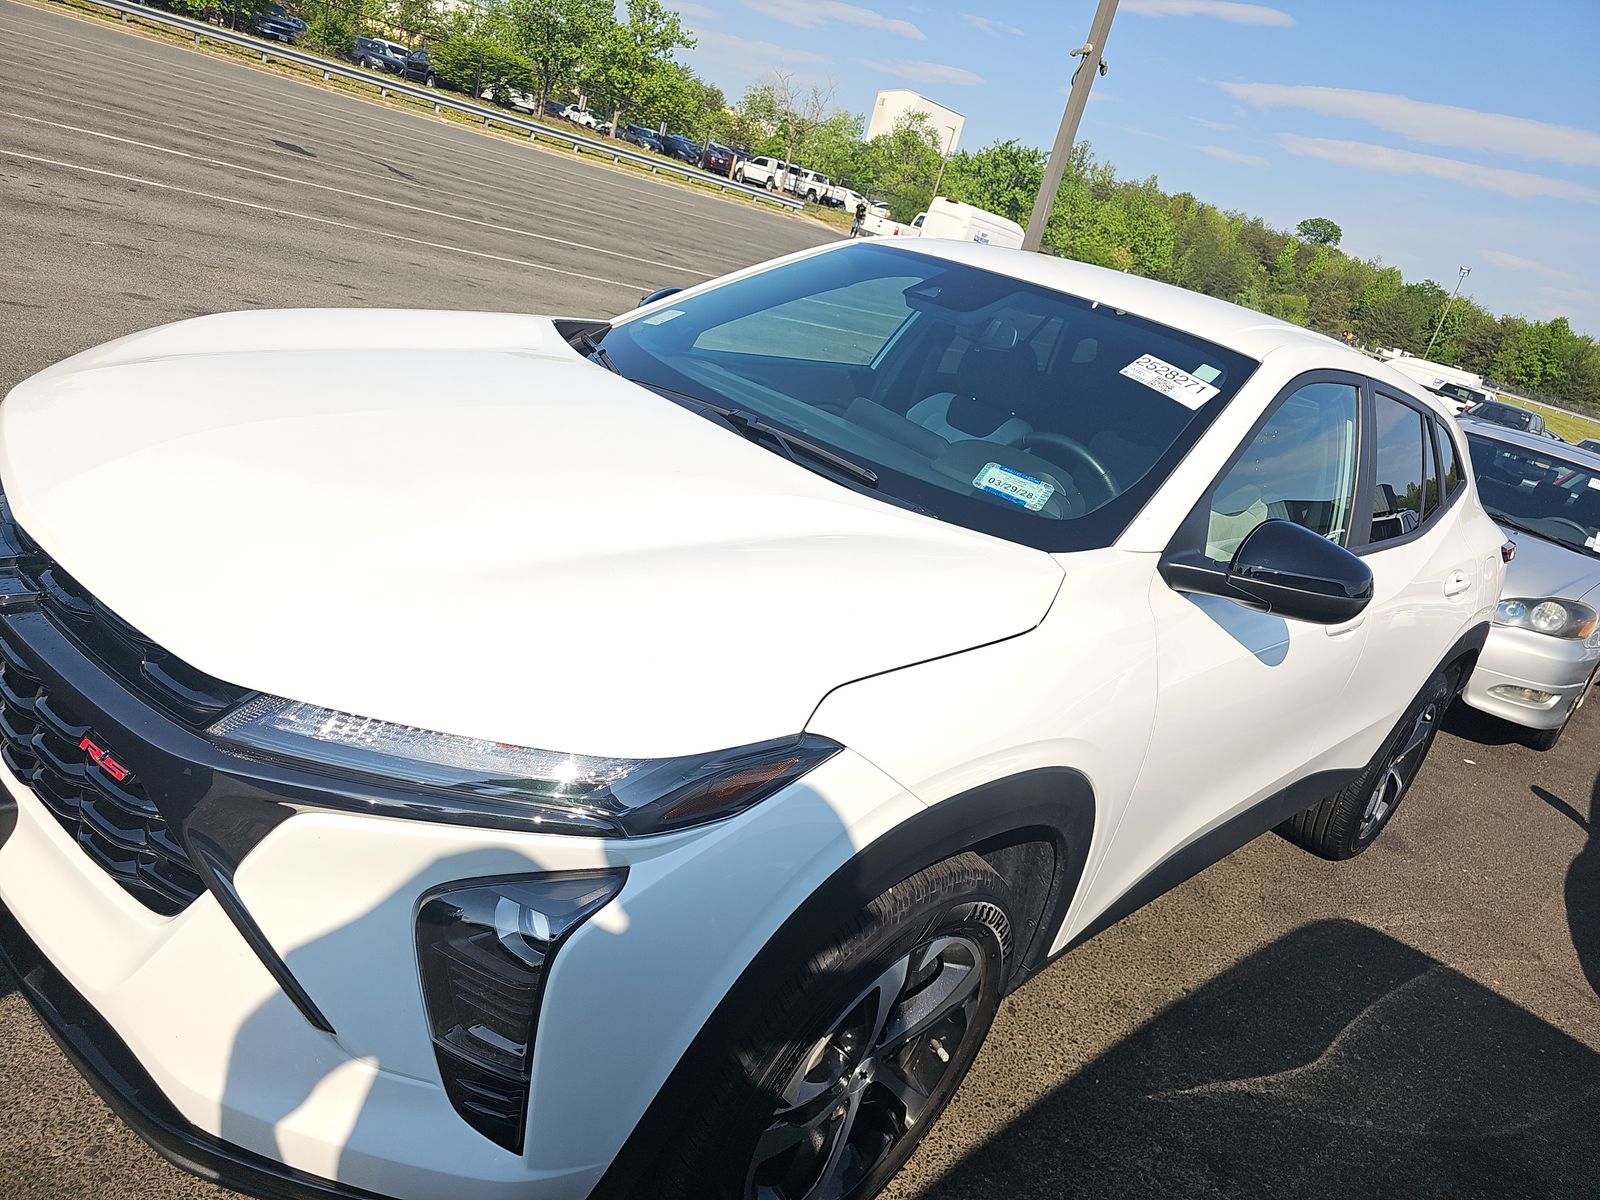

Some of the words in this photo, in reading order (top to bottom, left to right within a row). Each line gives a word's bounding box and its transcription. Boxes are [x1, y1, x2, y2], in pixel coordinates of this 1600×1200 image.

[1136, 357, 1206, 394] 2528271
[988, 477, 1034, 500] 03/29/28
[79, 737, 131, 781] RS
